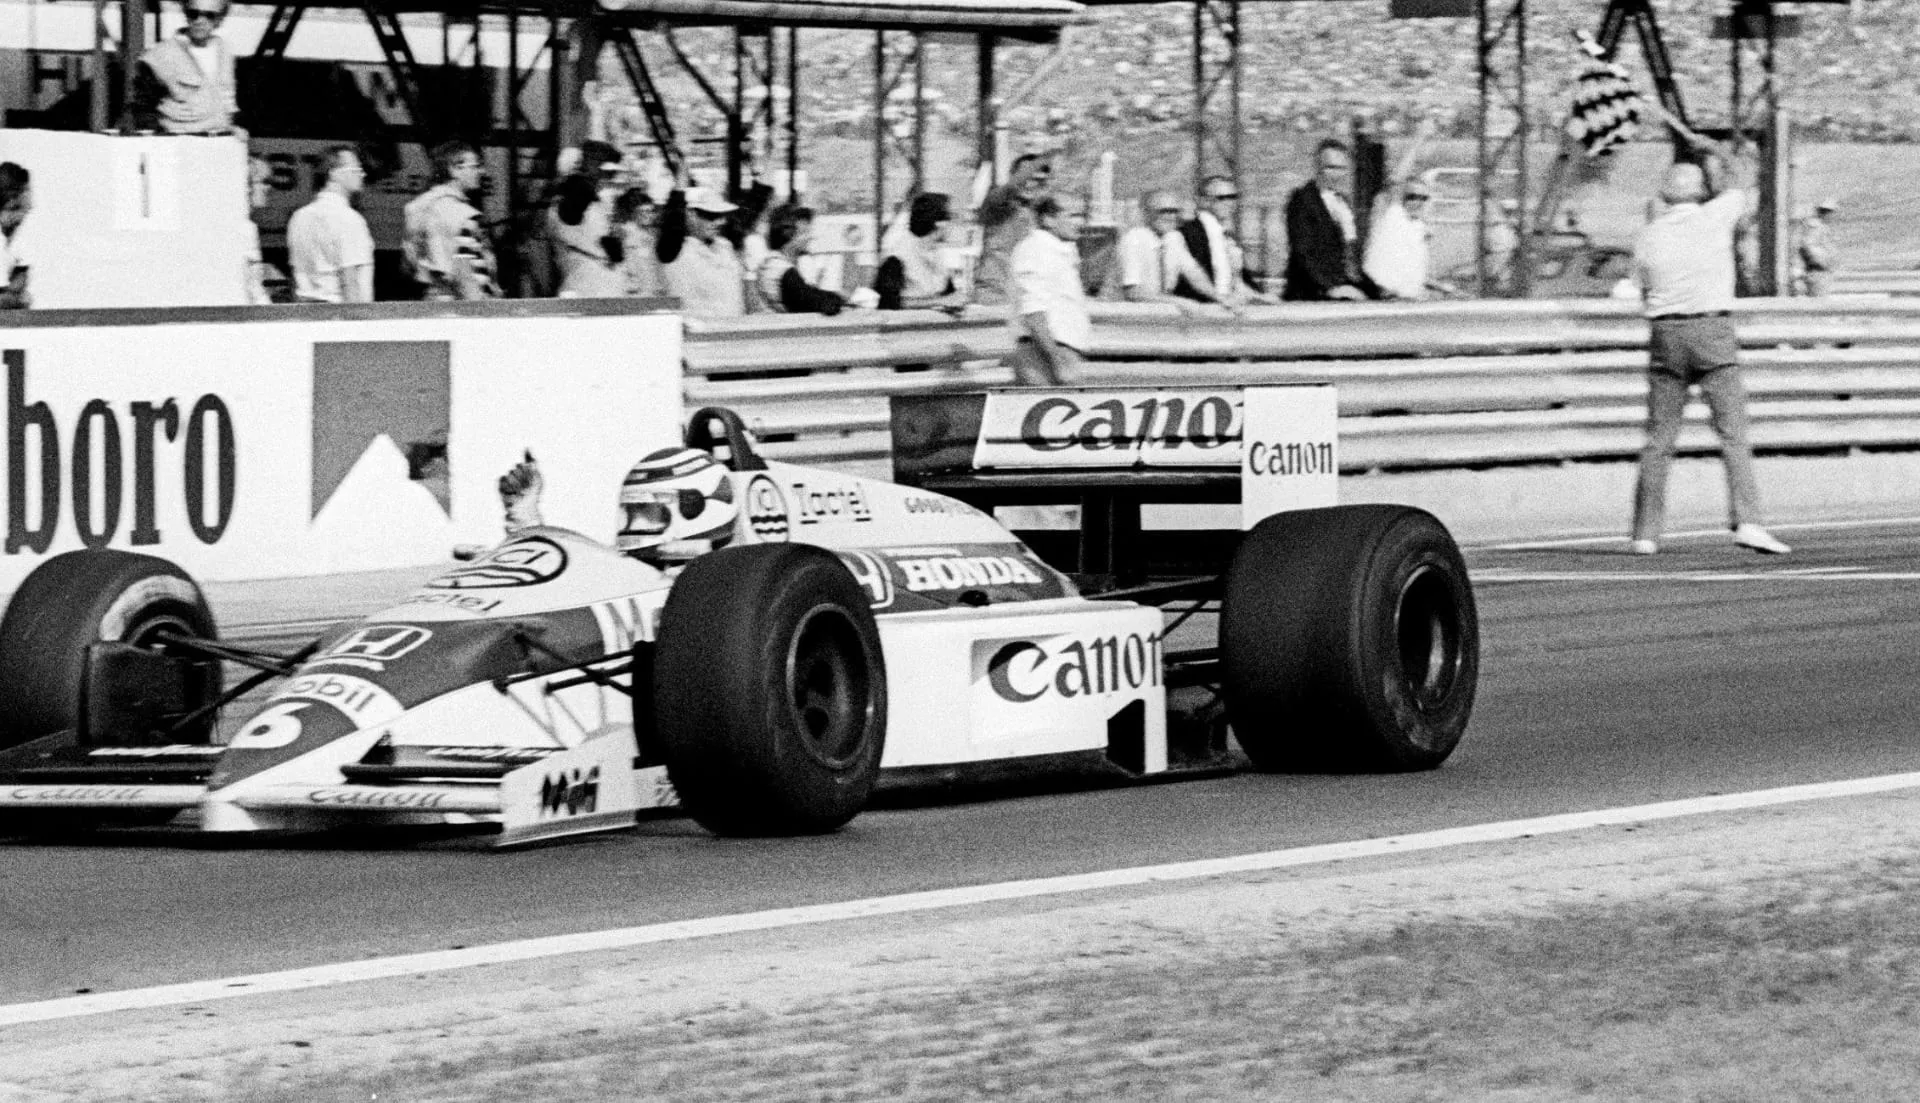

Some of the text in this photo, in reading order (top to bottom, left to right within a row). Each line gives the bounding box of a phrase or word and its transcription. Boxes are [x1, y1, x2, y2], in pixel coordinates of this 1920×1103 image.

[1021, 397, 1243, 451] Cano
[1249, 439, 1333, 475] Canon
[896, 556, 1043, 592] HONDA
[229, 701, 315, 749] 6
